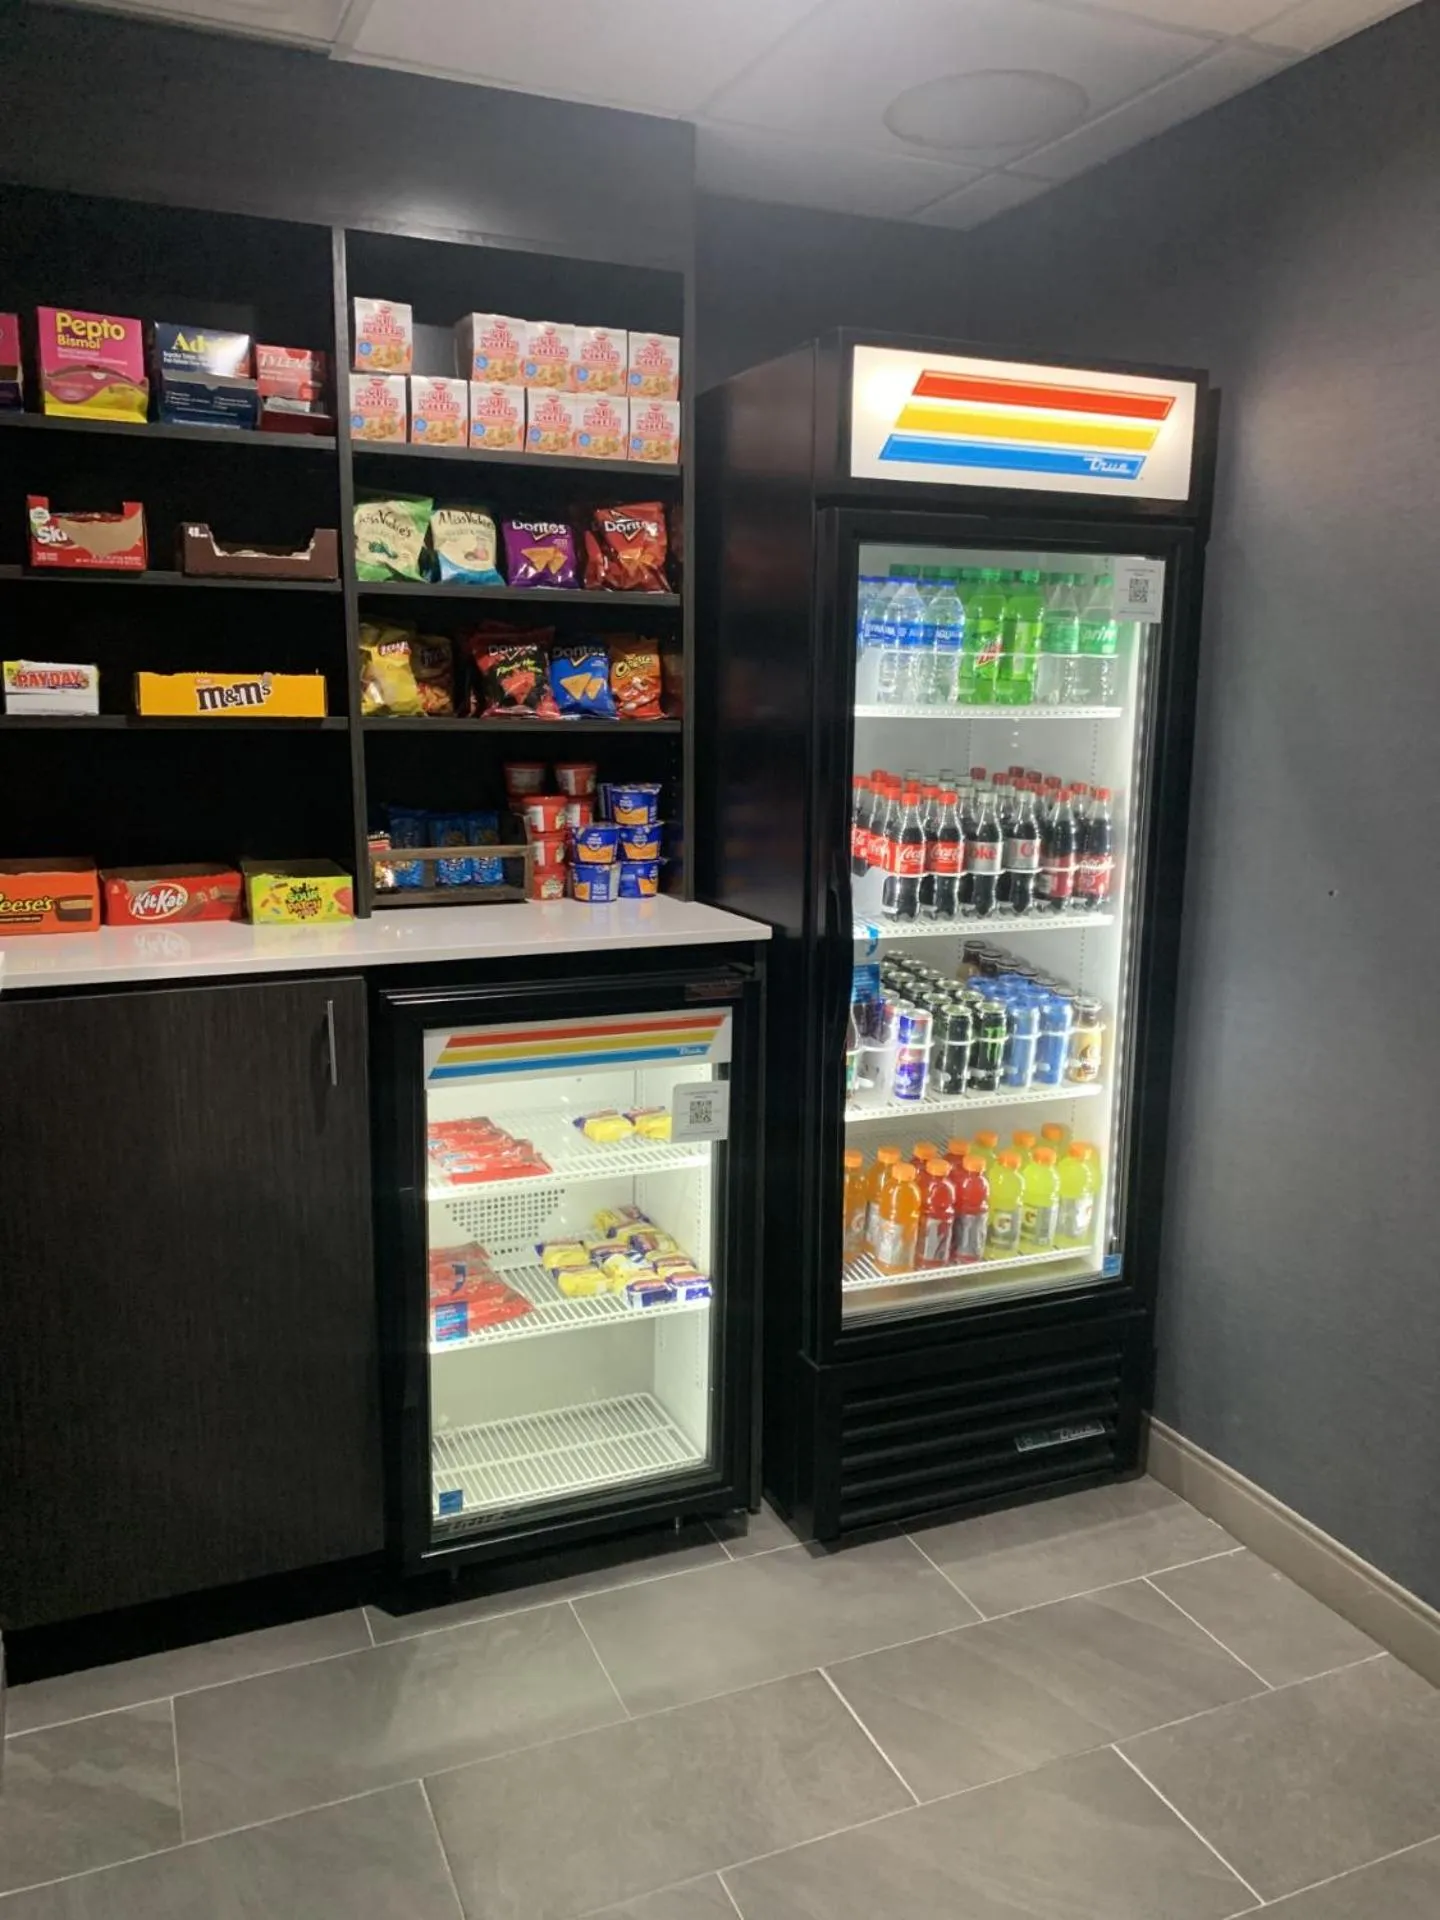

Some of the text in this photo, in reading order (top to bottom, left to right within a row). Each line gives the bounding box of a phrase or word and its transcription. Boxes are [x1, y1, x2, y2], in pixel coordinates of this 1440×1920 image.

[56, 312, 125, 341] Pepto
[57, 333, 101, 349] Bismol
[512, 519, 567, 535] Doritos
[605, 519, 658, 537] Doritos
[131, 889, 184, 915] KitKat
